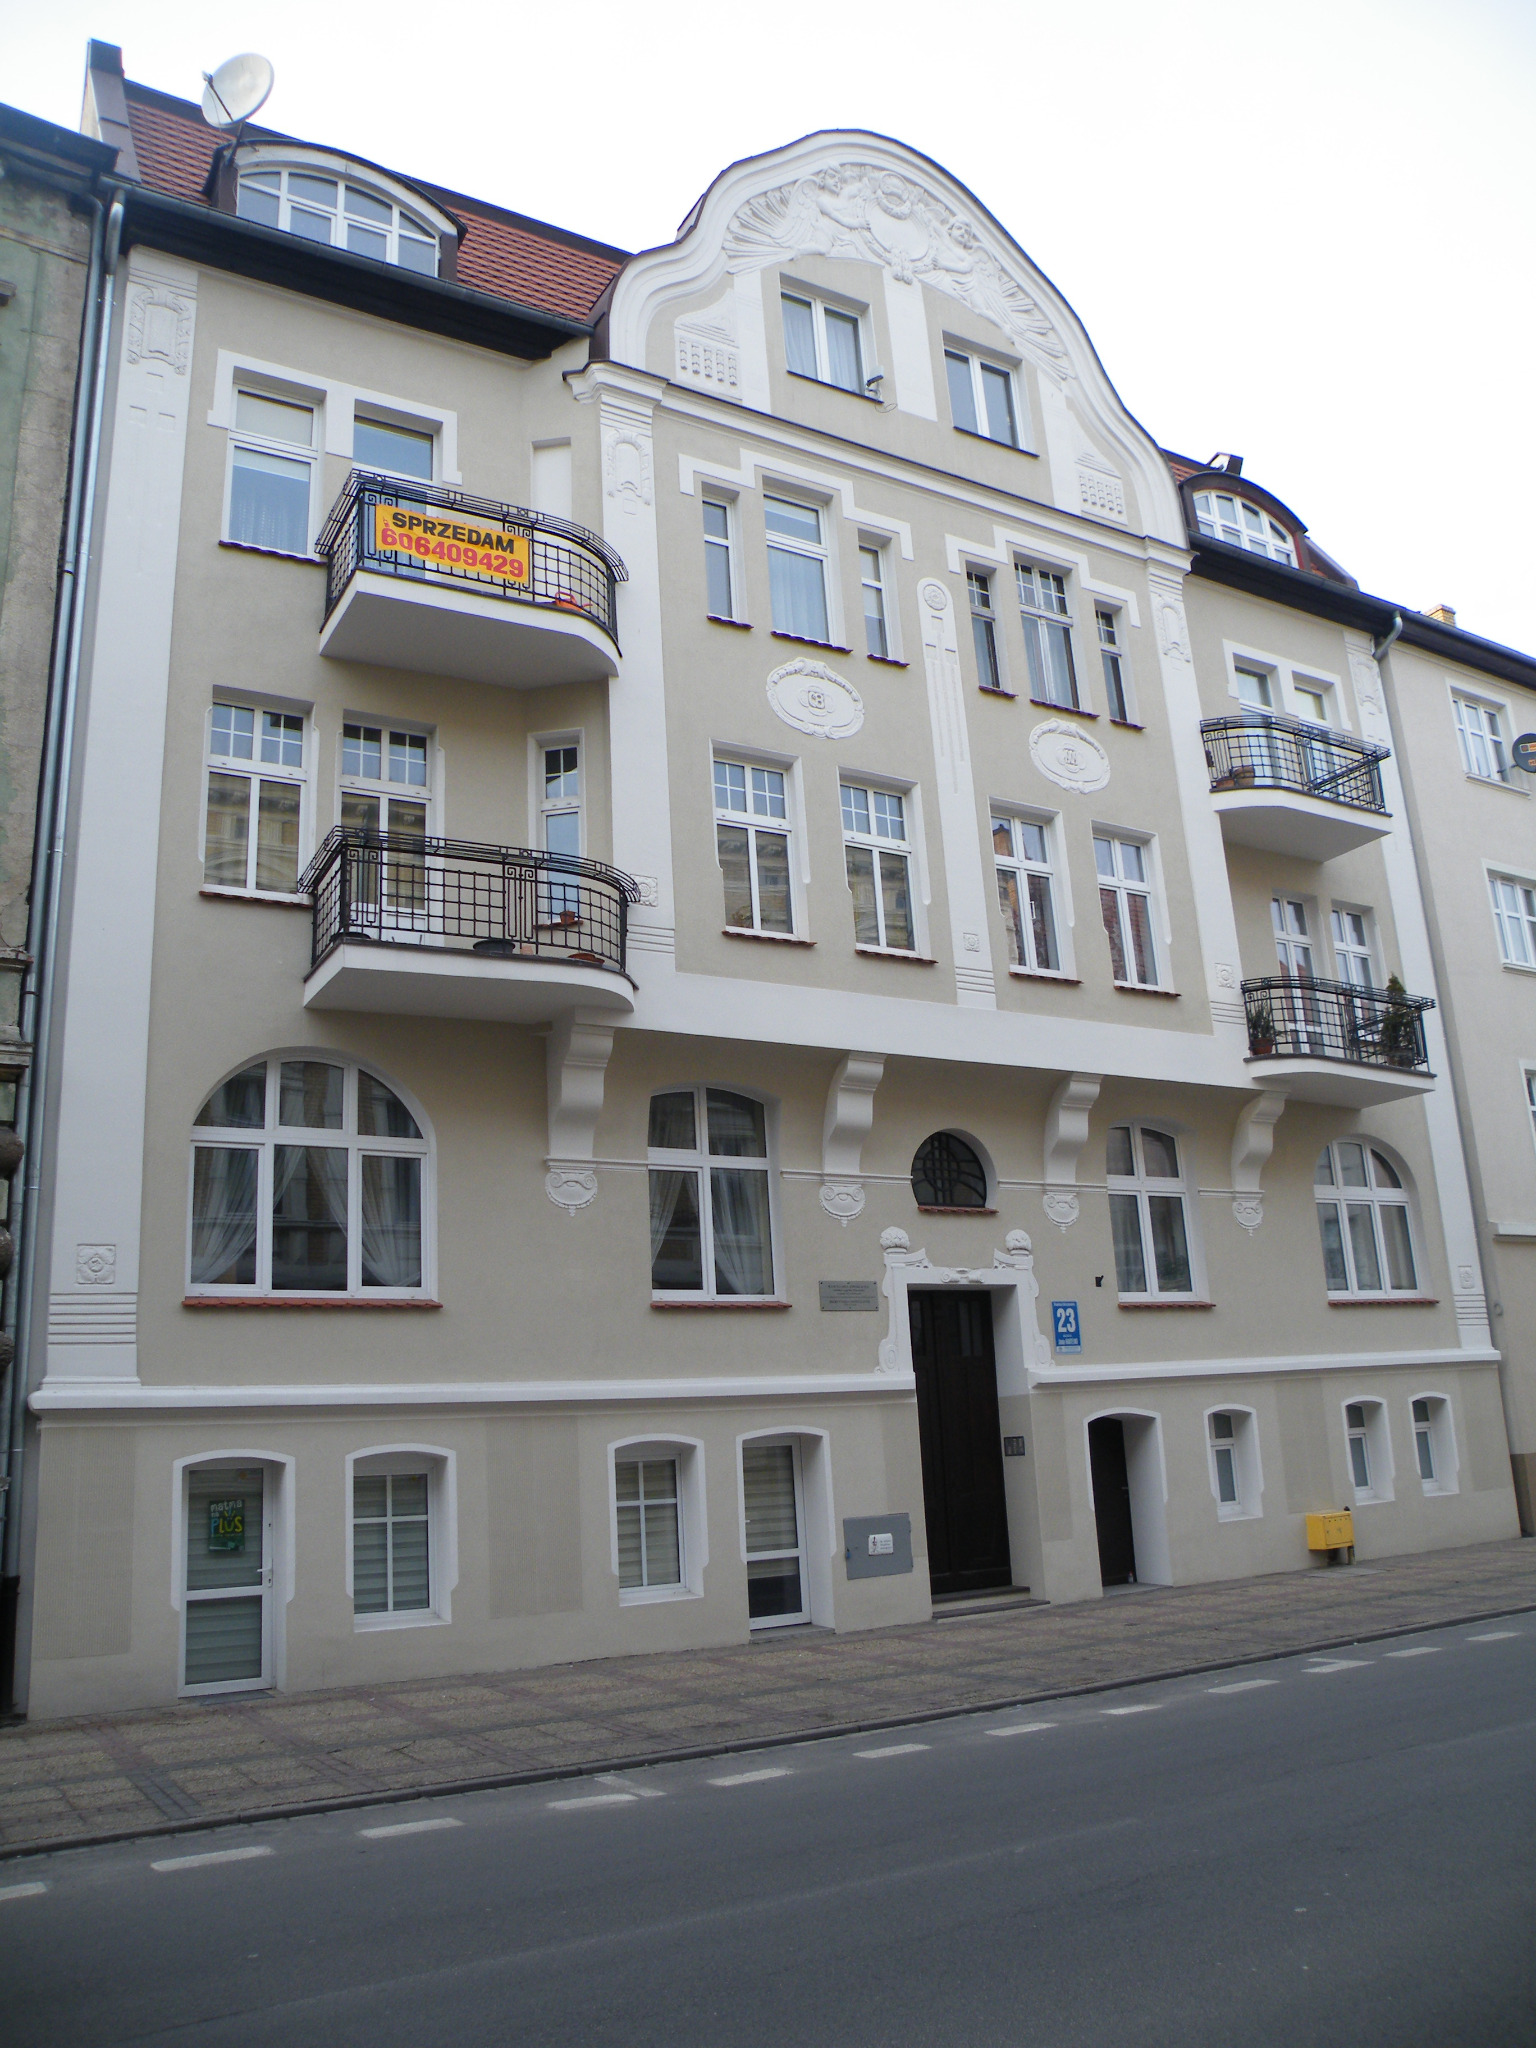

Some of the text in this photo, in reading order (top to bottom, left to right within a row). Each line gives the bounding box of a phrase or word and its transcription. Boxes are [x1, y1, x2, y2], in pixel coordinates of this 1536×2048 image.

[381, 527, 524, 578] 606409429
[392, 512, 515, 554] SPRZEDAM
[1057, 1308, 1076, 1333] 23
